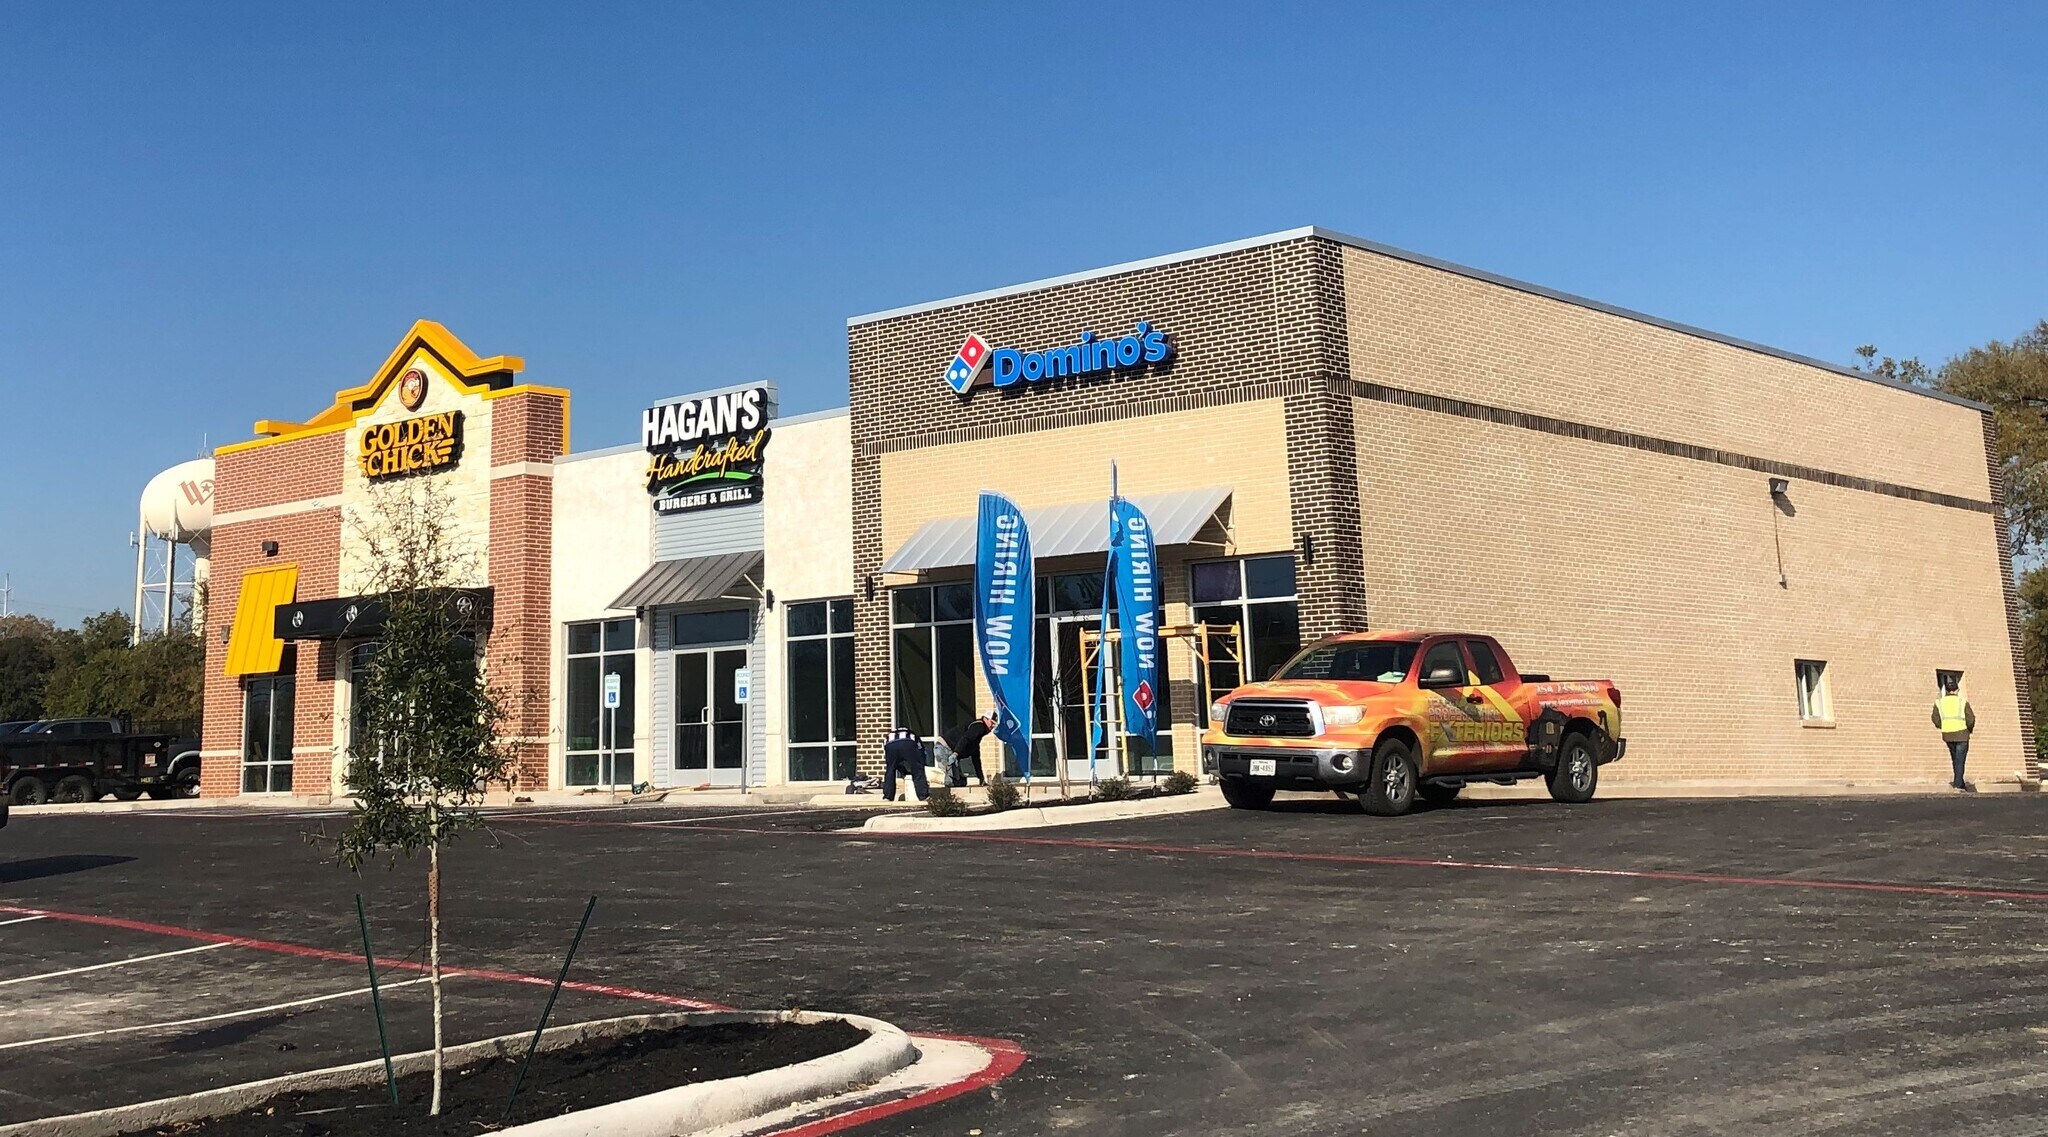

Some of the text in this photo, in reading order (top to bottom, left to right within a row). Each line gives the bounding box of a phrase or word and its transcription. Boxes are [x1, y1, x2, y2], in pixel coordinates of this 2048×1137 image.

[993, 321, 1167, 387] Domino's
[360, 412, 456, 457] GOLDEN
[642, 389, 760, 447] HAGAN'S
[366, 439, 446, 477] CHICK
[642, 429, 764, 488] Handcrafted
[658, 487, 752, 511] BURGERS & GRILL
[1429, 721, 1525, 742] EXTERIORS
